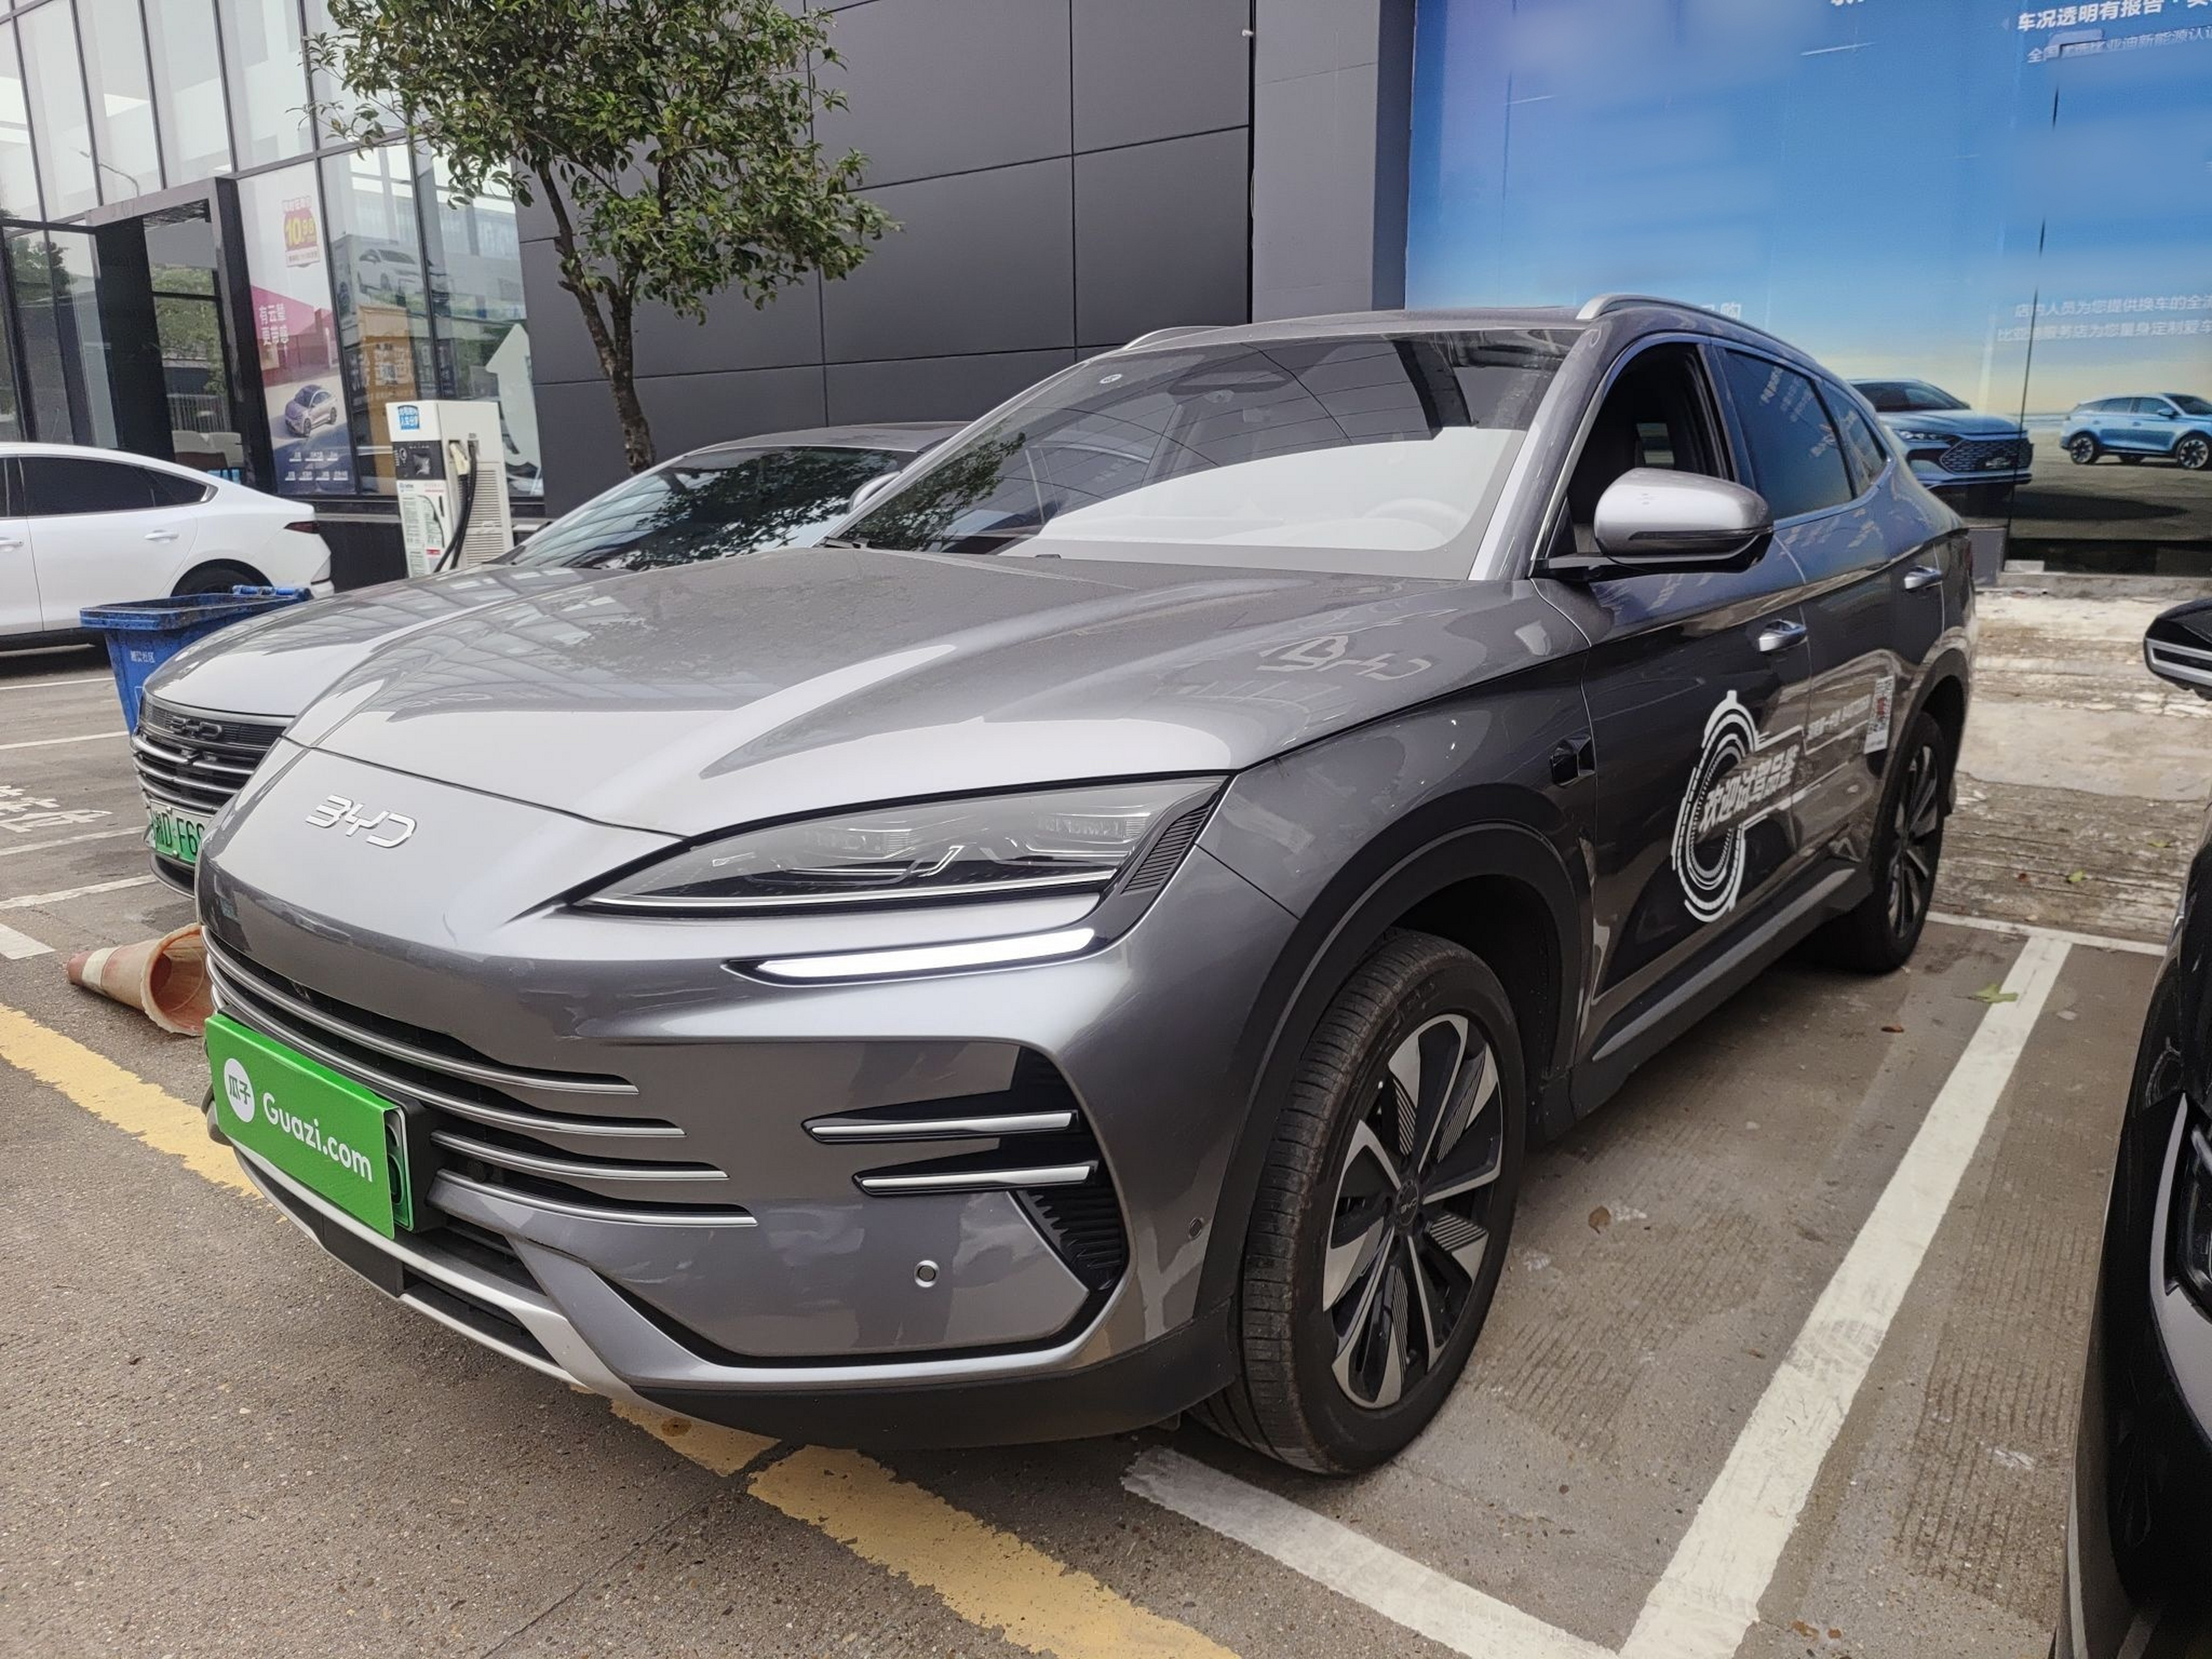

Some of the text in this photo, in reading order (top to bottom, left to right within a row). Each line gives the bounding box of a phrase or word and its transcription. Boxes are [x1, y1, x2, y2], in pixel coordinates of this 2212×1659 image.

[171, 715, 222, 738] BYD
[305, 794, 417, 849] BYD
[228, 1075, 251, 1105] 瓜子
[263, 1092, 373, 1183] Guazi.com
